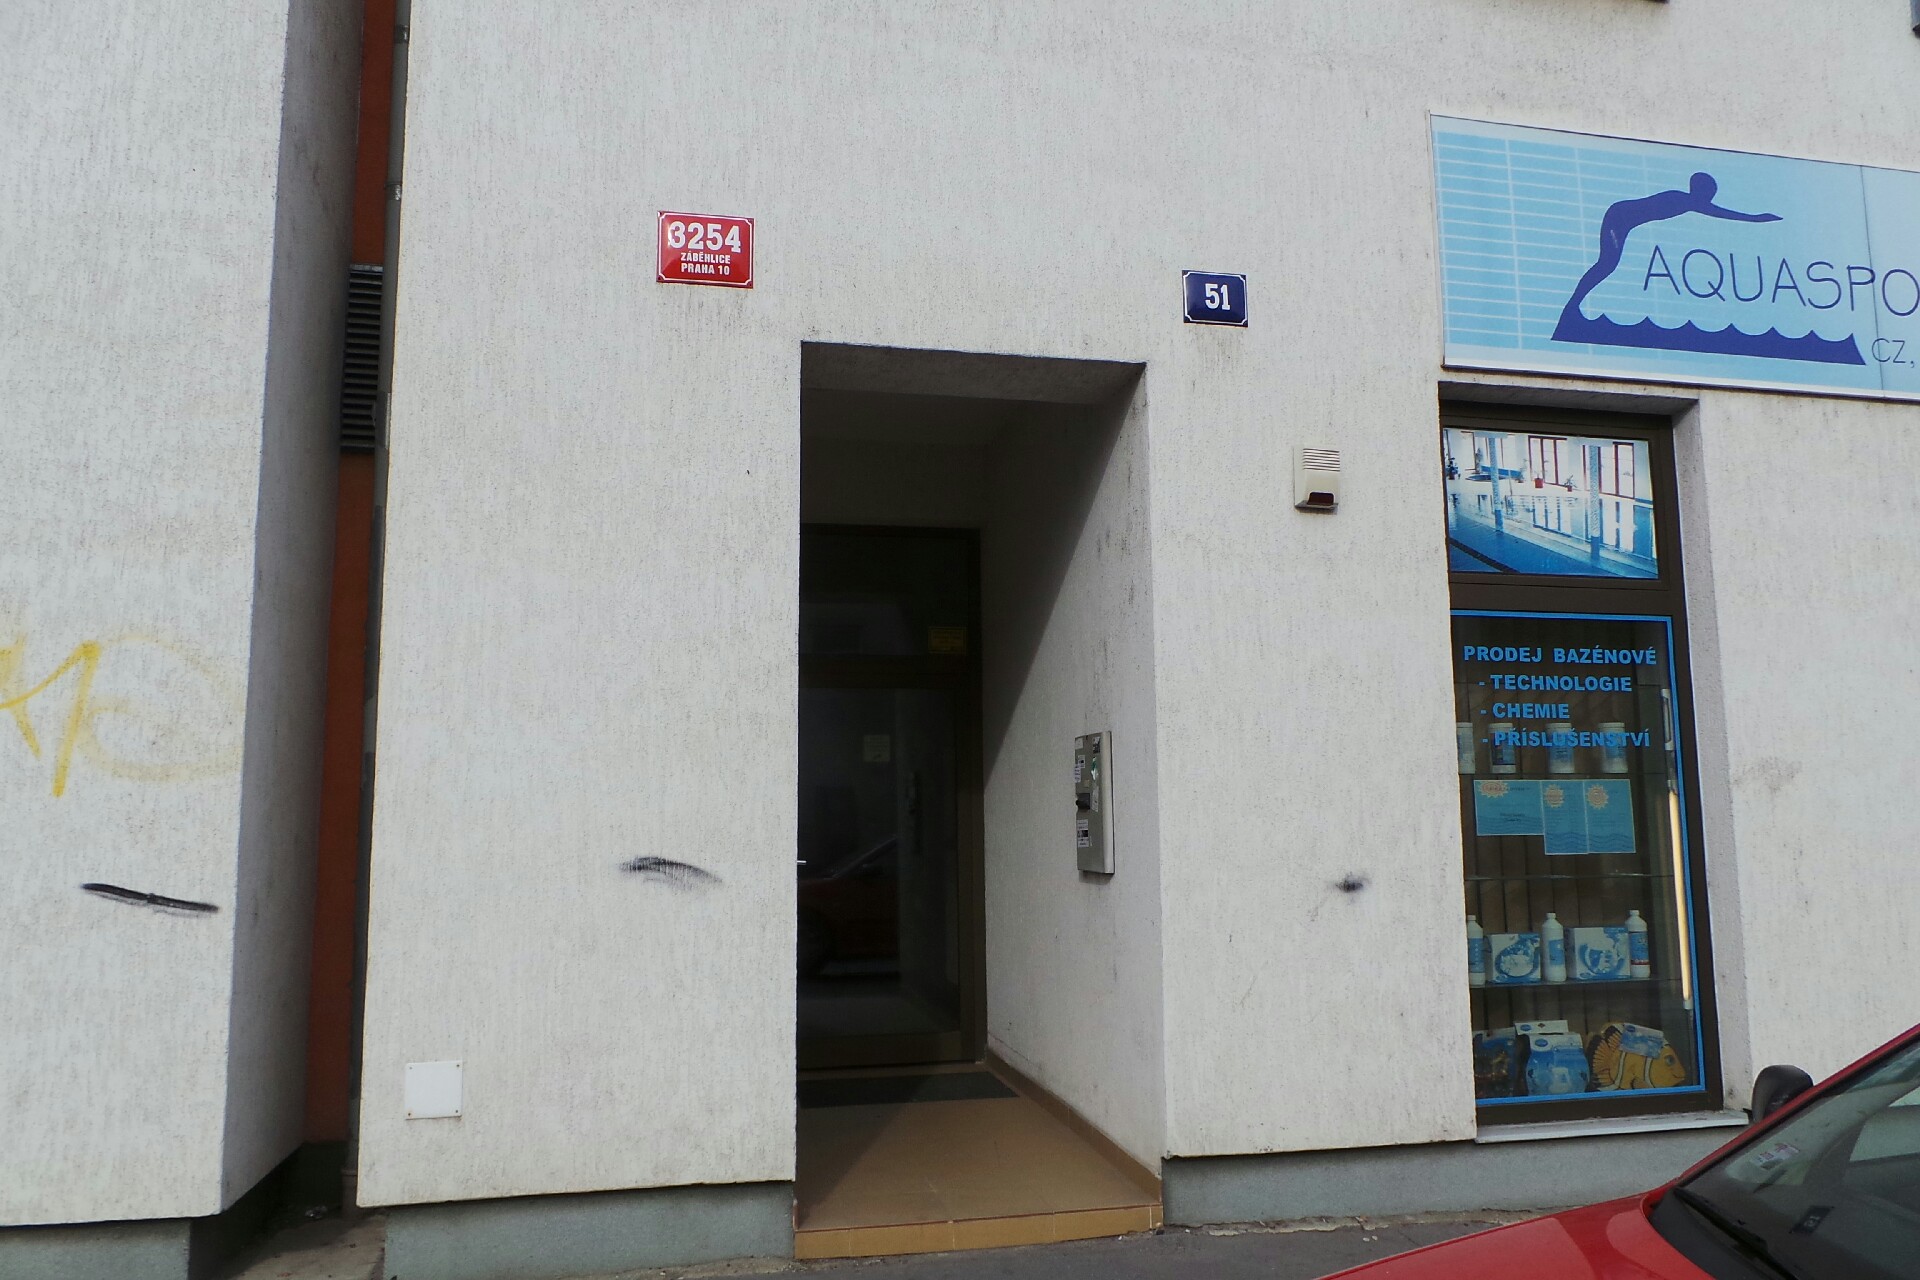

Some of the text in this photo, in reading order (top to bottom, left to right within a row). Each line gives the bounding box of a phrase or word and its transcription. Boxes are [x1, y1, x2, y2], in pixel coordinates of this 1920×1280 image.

[668, 221, 741, 253] 3254
[681, 263, 730, 275] PRAHA 10
[1643, 245, 1920, 317] AQUASPO
[1205, 283, 1231, 311] 51
[1464, 645, 1657, 665] PRODEJ BAZÉNOVÉ
[1490, 674, 1633, 692] TECHNOLOGIE
[1492, 702, 1570, 719] CHEMIE
[1494, 728, 1650, 747] PŘÍSLUŠENSTVÍ
